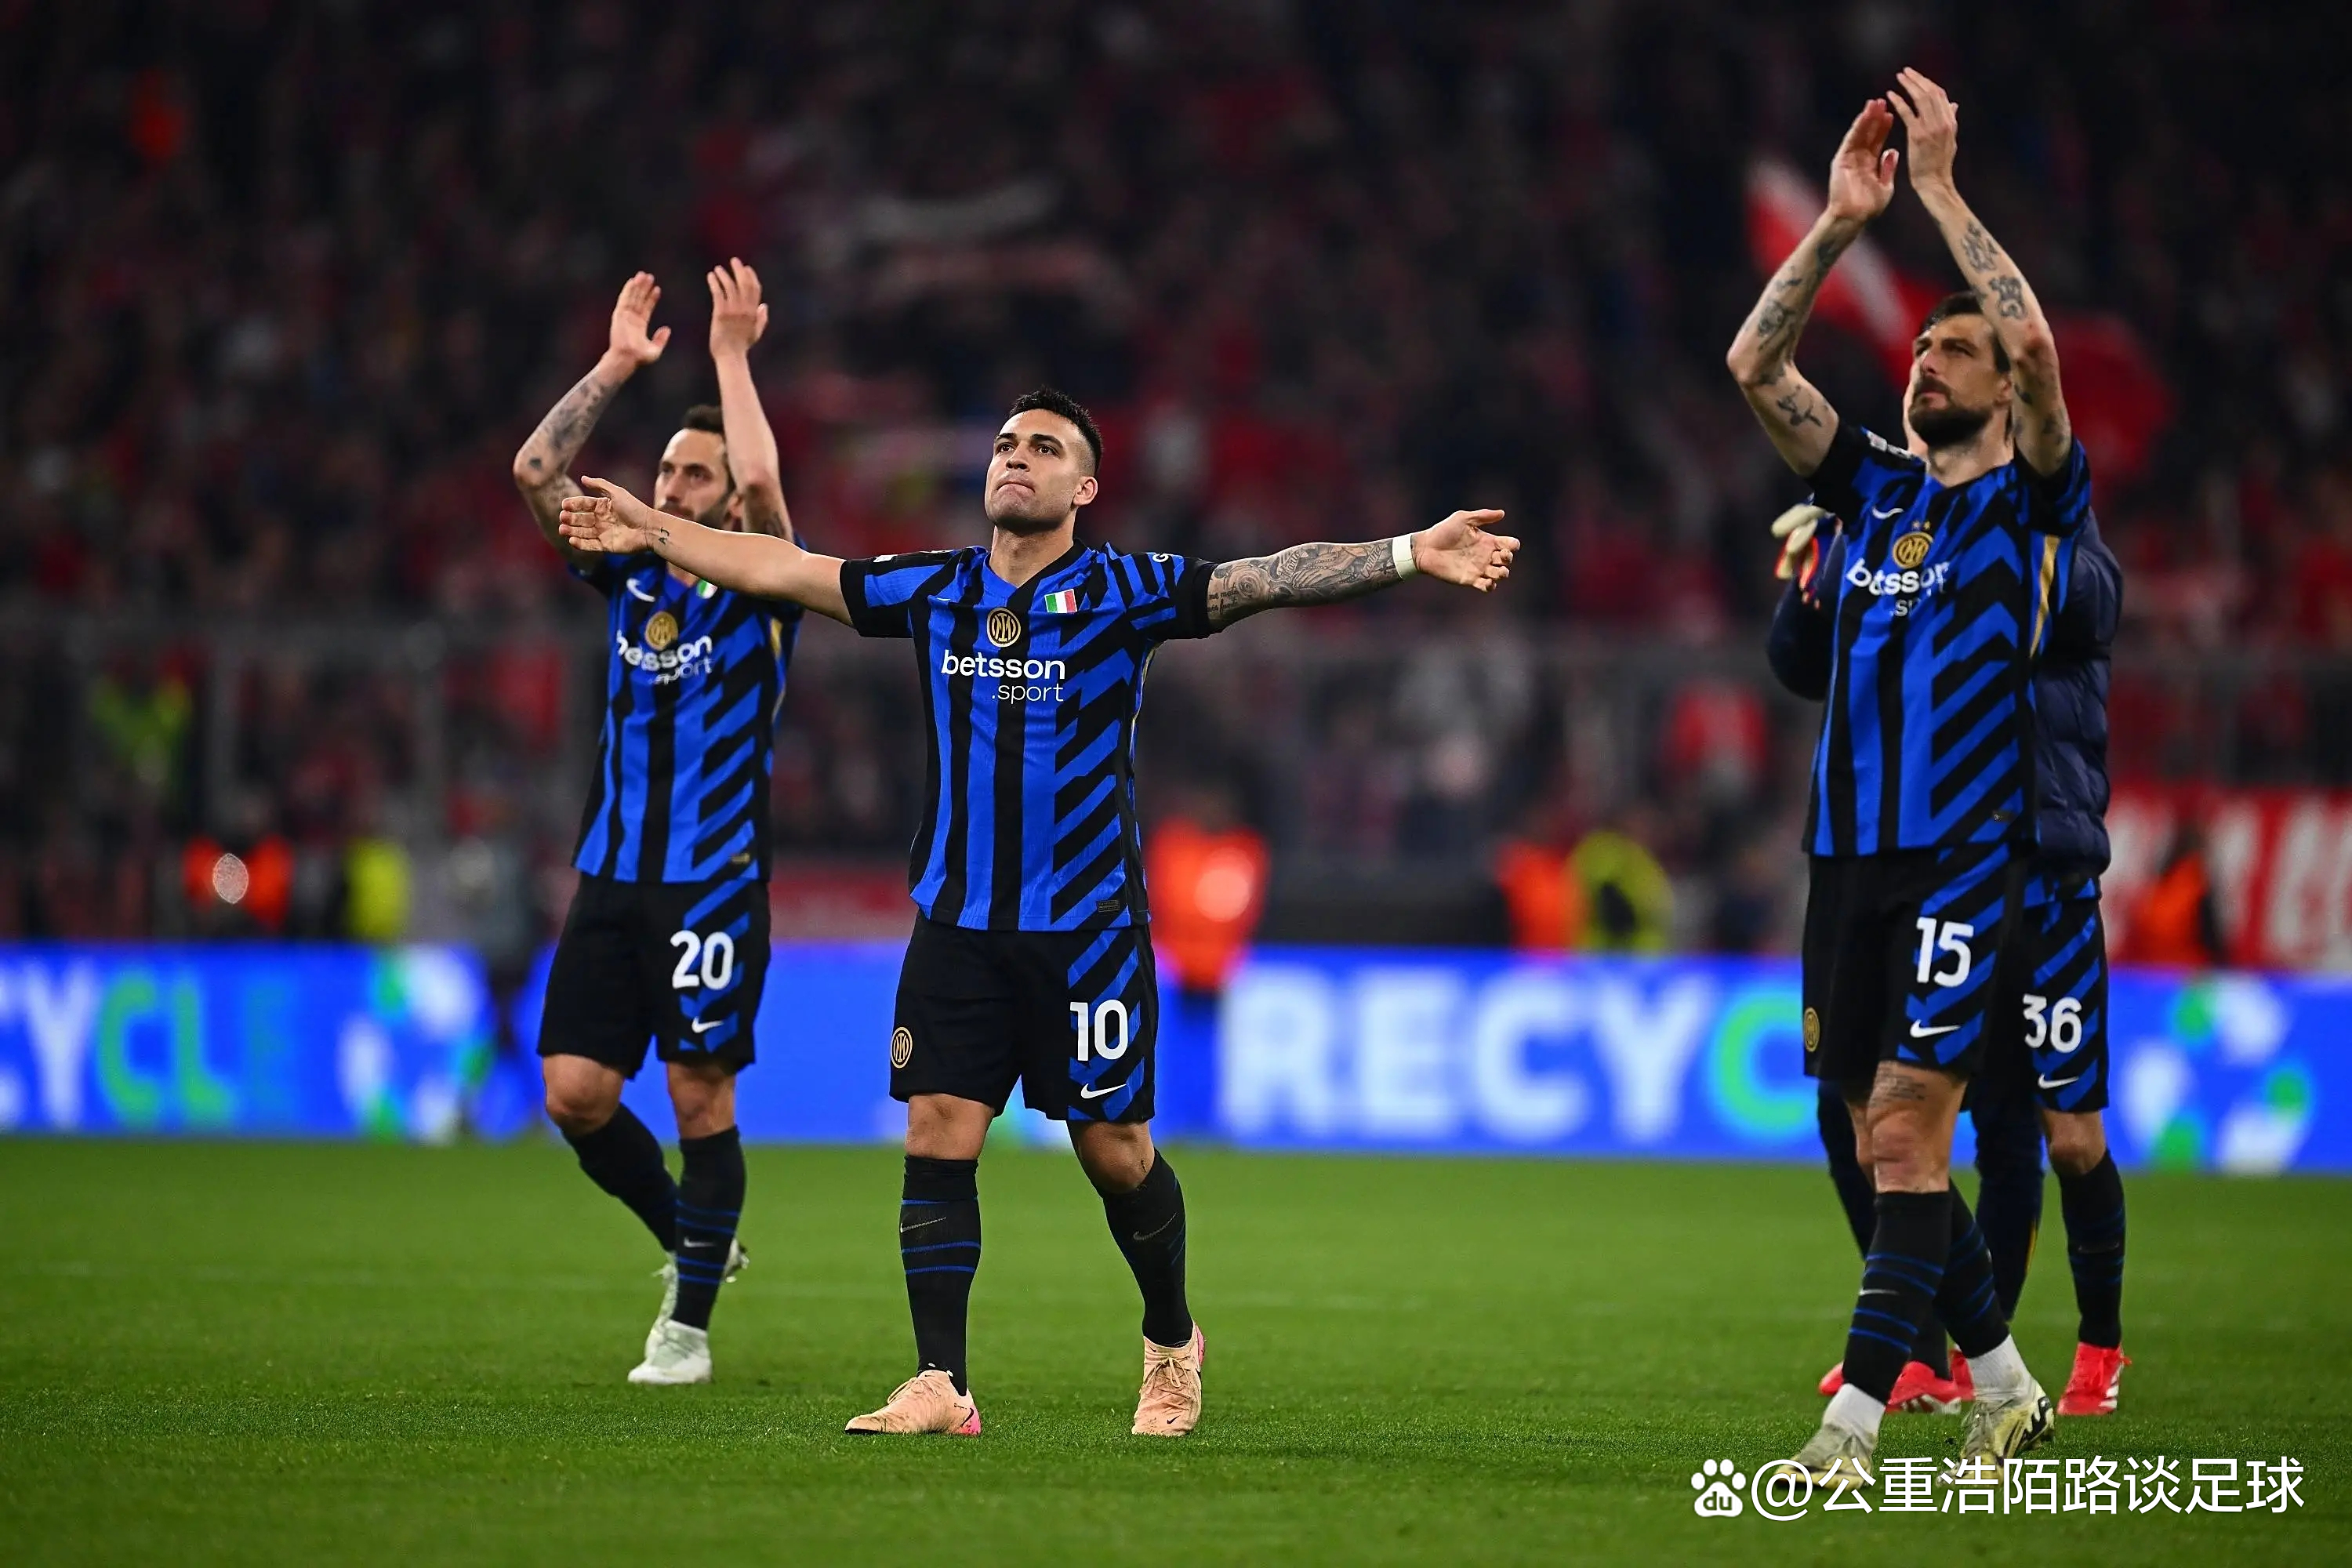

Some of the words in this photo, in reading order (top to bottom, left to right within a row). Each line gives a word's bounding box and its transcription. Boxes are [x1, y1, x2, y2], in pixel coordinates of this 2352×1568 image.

[941, 649, 1065, 680] betsson
[991, 683, 1065, 704] .sport
[670, 930, 735, 990] 20
[1916, 916, 1974, 988] 15
[1069, 1000, 1129, 1062] 10
[2023, 994, 2082, 1054] 36
